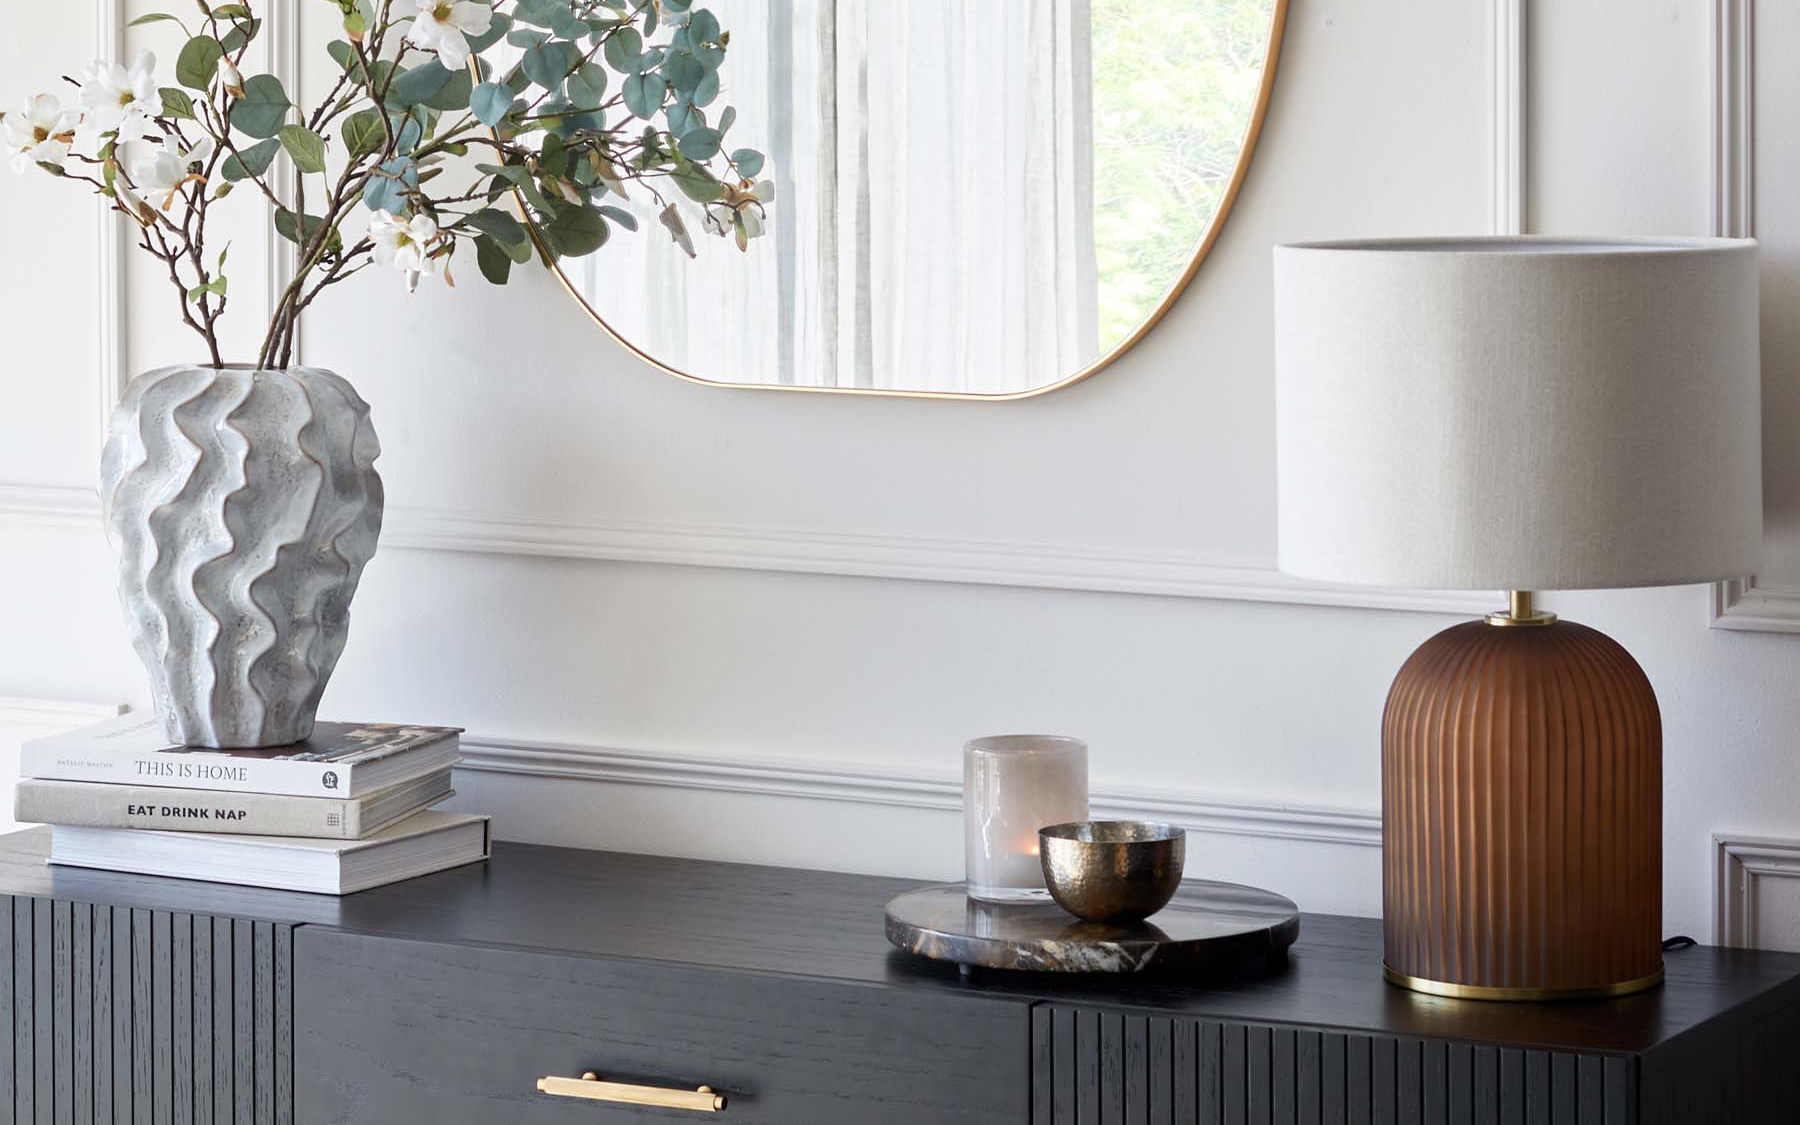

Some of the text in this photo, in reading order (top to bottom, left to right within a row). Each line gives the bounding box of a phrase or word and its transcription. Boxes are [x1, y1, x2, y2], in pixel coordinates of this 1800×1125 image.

[135, 760, 248, 781] THIS IS HOME
[127, 804, 247, 821] EAT DRINK NAP
